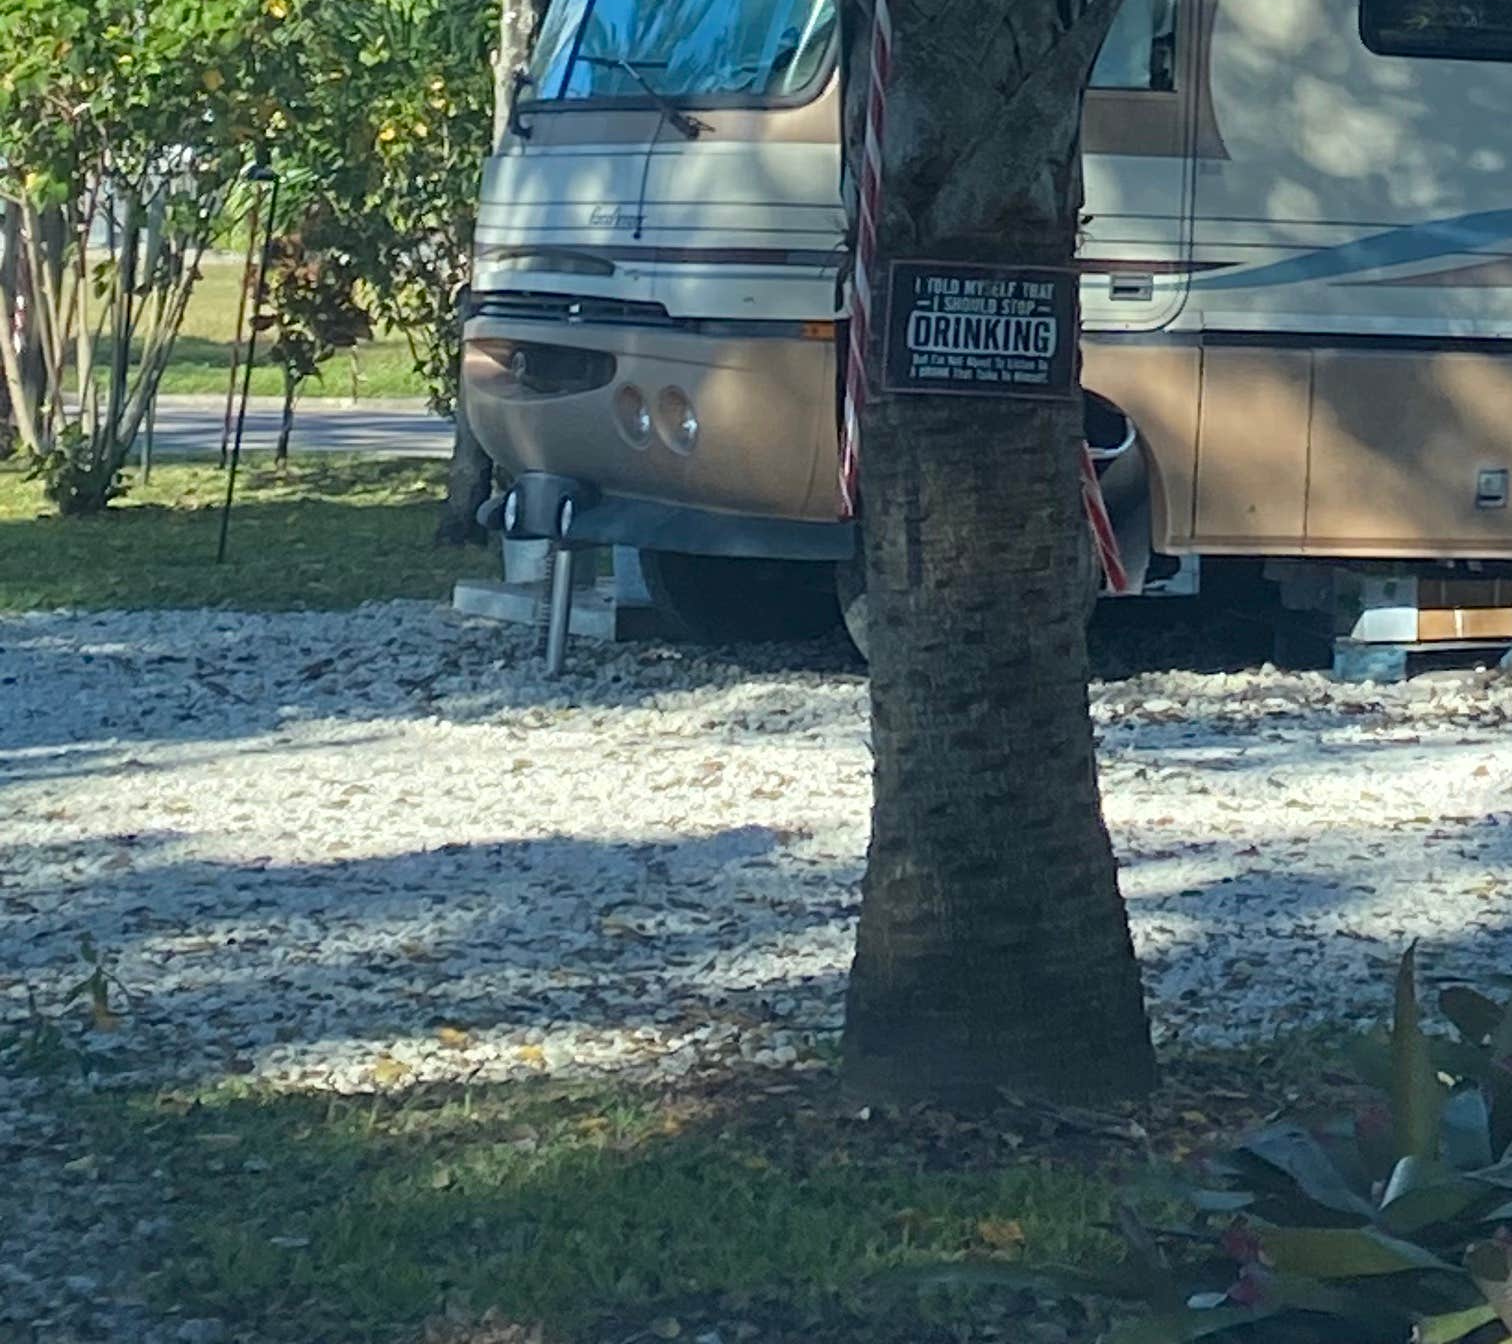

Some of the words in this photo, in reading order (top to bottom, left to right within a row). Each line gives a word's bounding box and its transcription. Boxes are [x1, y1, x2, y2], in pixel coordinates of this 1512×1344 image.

[914, 277, 921, 294] I
[927, 277, 960, 295] TOLD
[964, 279, 1017, 297] MYSELF
[1023, 282, 1054, 299] THAT
[944, 296, 997, 314] SHOULD
[1002, 299, 1036, 316] STOP
[913, 315, 1051, 353] DRINKING
